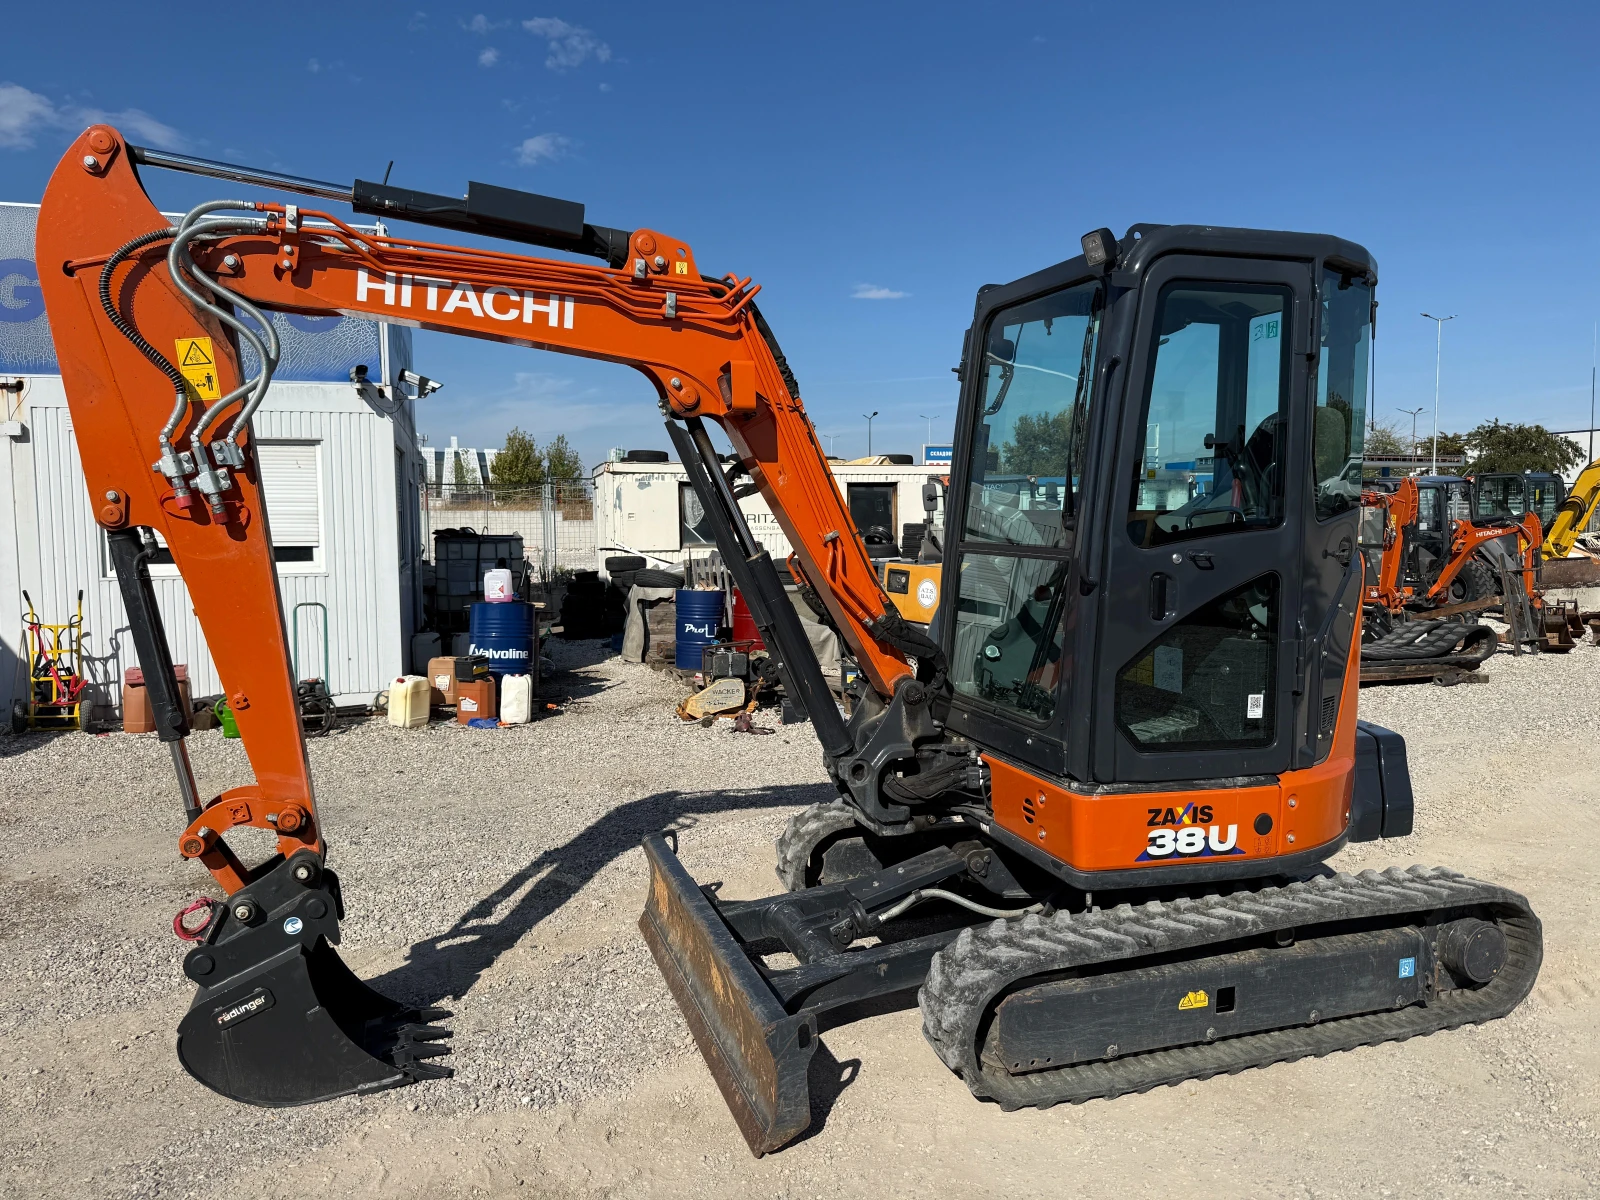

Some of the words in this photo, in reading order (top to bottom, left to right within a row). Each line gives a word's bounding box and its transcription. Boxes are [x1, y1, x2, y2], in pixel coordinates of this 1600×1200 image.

[356, 268, 575, 329] HITACHI
[743, 513, 778, 524] RITZ
[1475, 529, 1503, 538] HITACHI
[684, 623, 719, 638] ProLi
[470, 645, 529, 659] Valvoline
[1146, 802, 1214, 826] ZAXIS
[1146, 824, 1238, 858] 38U
[217, 995, 266, 1024] rädlinger
